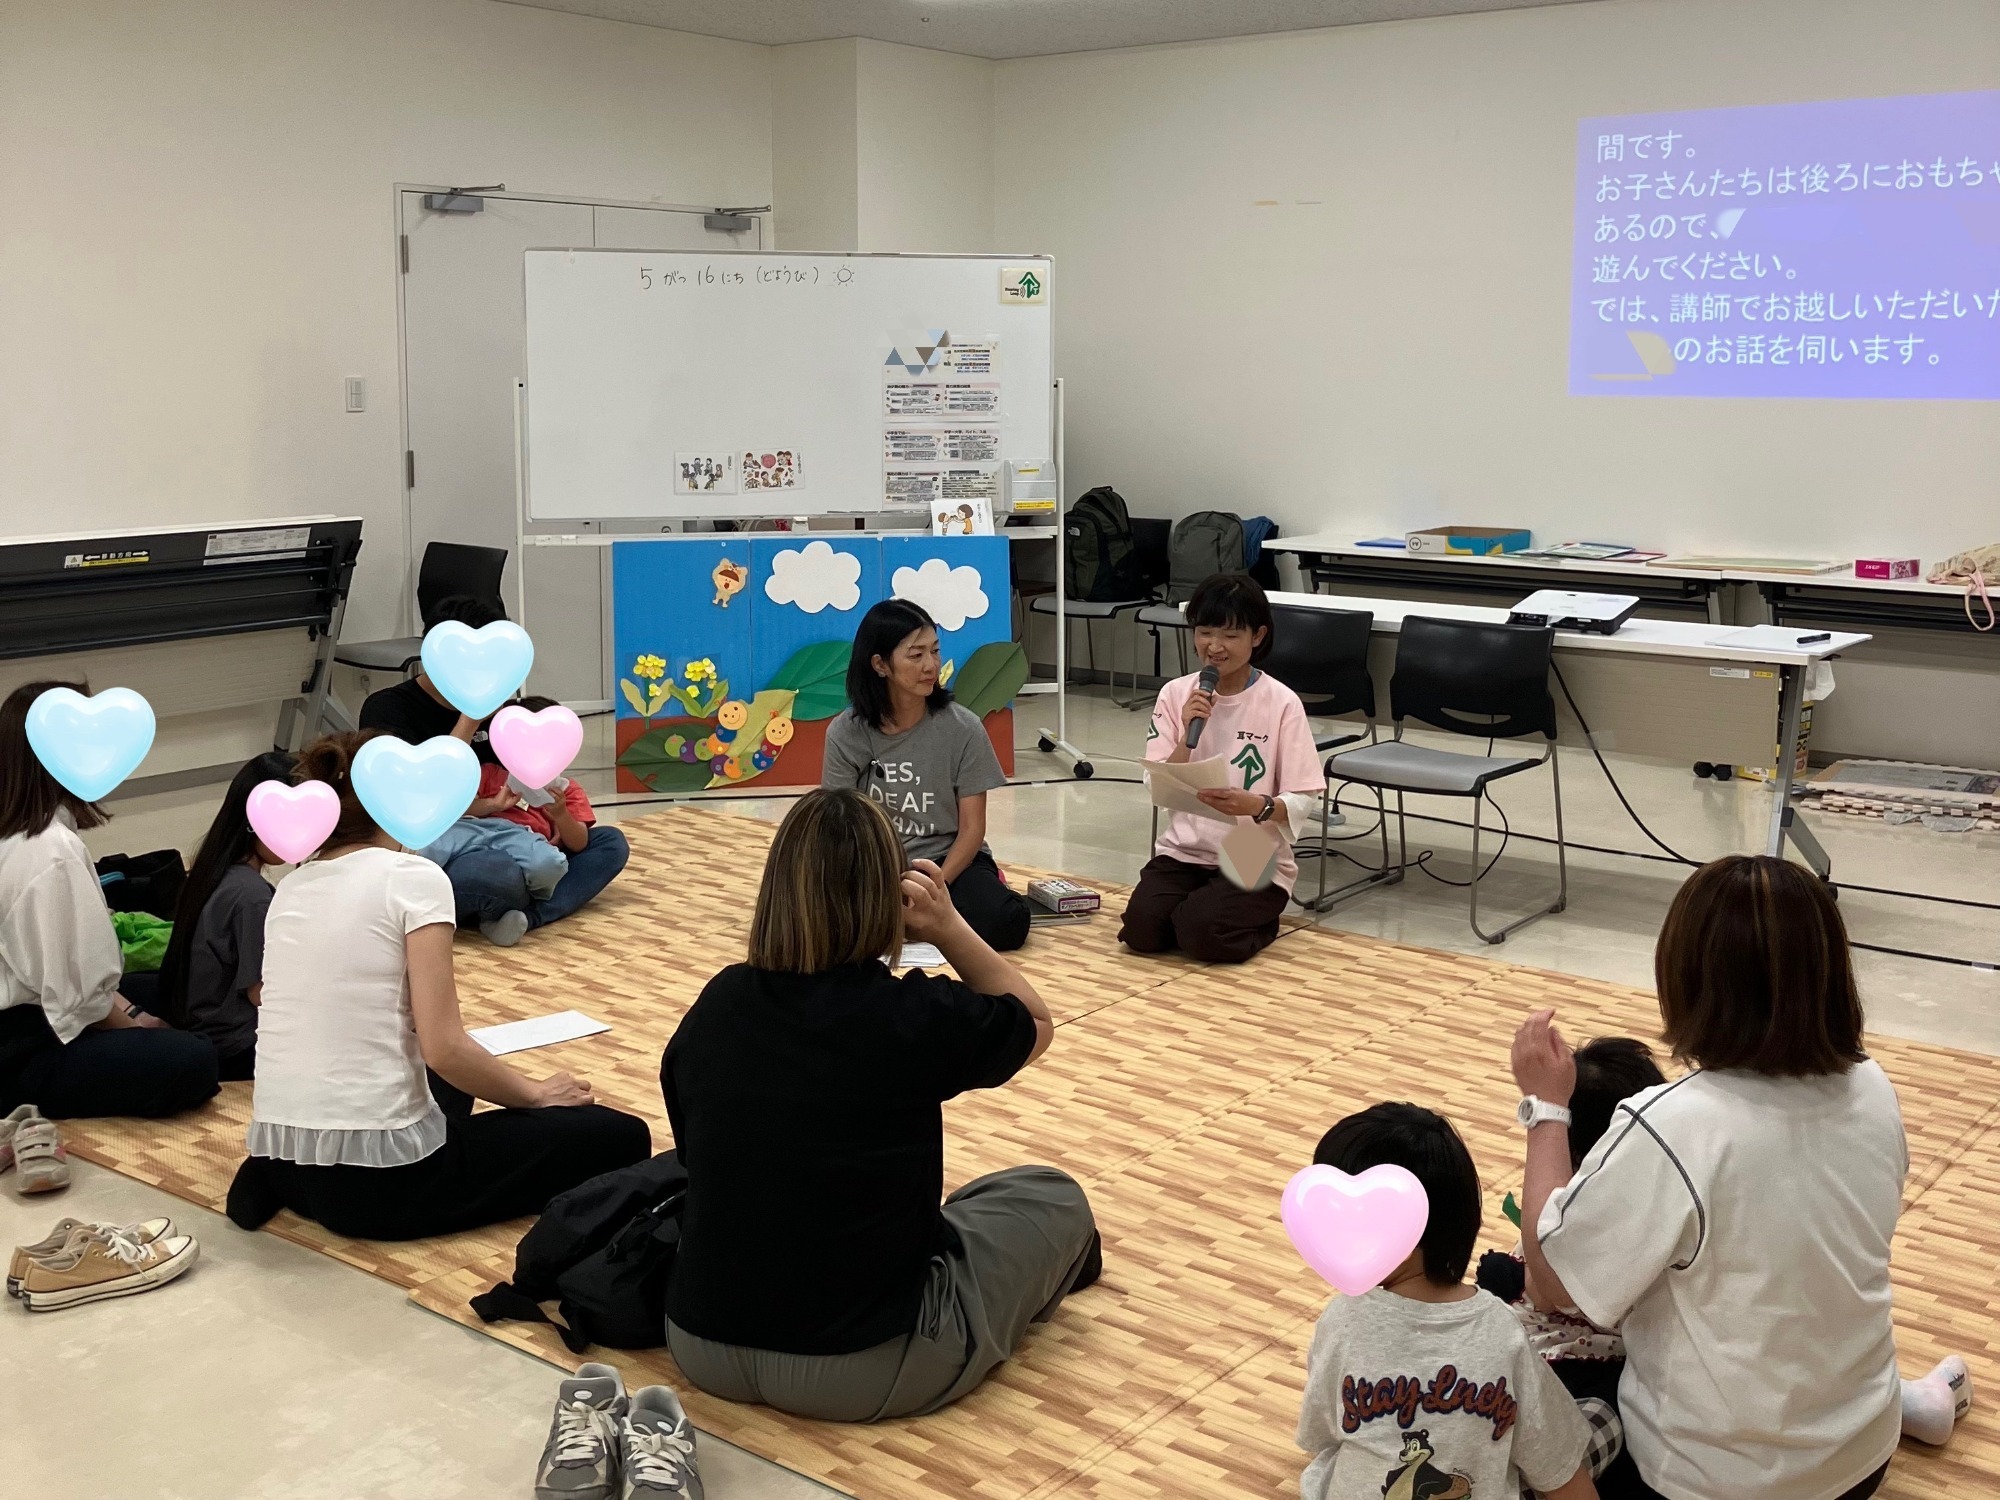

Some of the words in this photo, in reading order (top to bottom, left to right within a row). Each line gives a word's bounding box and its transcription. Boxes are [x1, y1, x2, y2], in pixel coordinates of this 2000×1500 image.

[1597, 130, 1696, 163] 間です。
[1594, 213, 1720, 243] あるので、
[640, 267, 653, 289] 5
[697, 264, 714, 285] 16
[721, 272, 744, 285] にち
[1592, 250, 1797, 284] 遊んでください。
[1674, 333, 1941, 366] のお話を伺います。
[1236, 730, 1269, 744] 耳マーク
[880, 761, 921, 786] ES,
[869, 783, 935, 813] DEAF
[1342, 1375, 1422, 1433] Stay
[1421, 1364, 1518, 1441] Lucky
